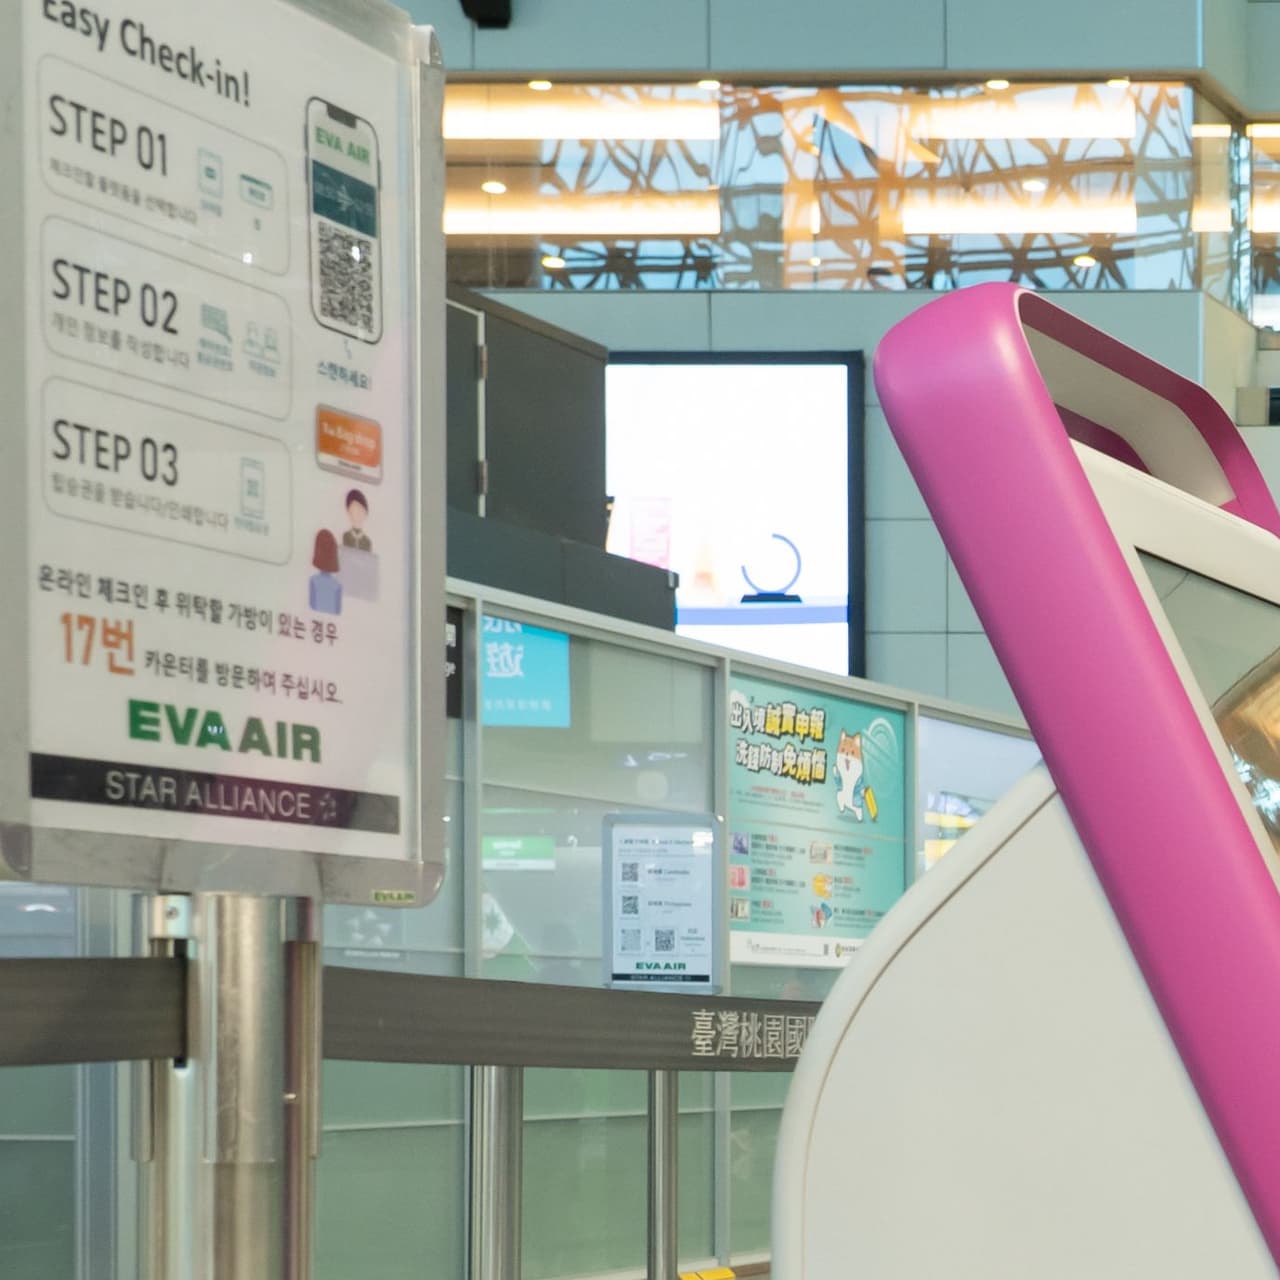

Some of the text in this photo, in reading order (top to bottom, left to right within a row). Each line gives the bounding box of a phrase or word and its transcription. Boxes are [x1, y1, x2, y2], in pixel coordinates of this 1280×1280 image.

[43, 0, 251, 107] Easy Check-in!
[49, 95, 168, 176] STEP 01
[315, 126, 371, 164] EVA AIR
[52, 259, 179, 335] STEP 02
[52, 419, 179, 486] STEP 03
[38, 564, 92, 599] 온라인
[97, 576, 149, 610] 체크인
[154, 588, 170, 608] 후
[228, 602, 273, 633] 가방이
[277, 613, 307, 640] 있는
[311, 619, 338, 645] 경우
[60, 612, 135, 676] 17번
[144, 650, 210, 684] 카운터를
[127, 698, 322, 763] EVA AIR
[105, 770, 312, 819] STAR ALLIANCE
[636, 962, 686, 971] EVA AIR
